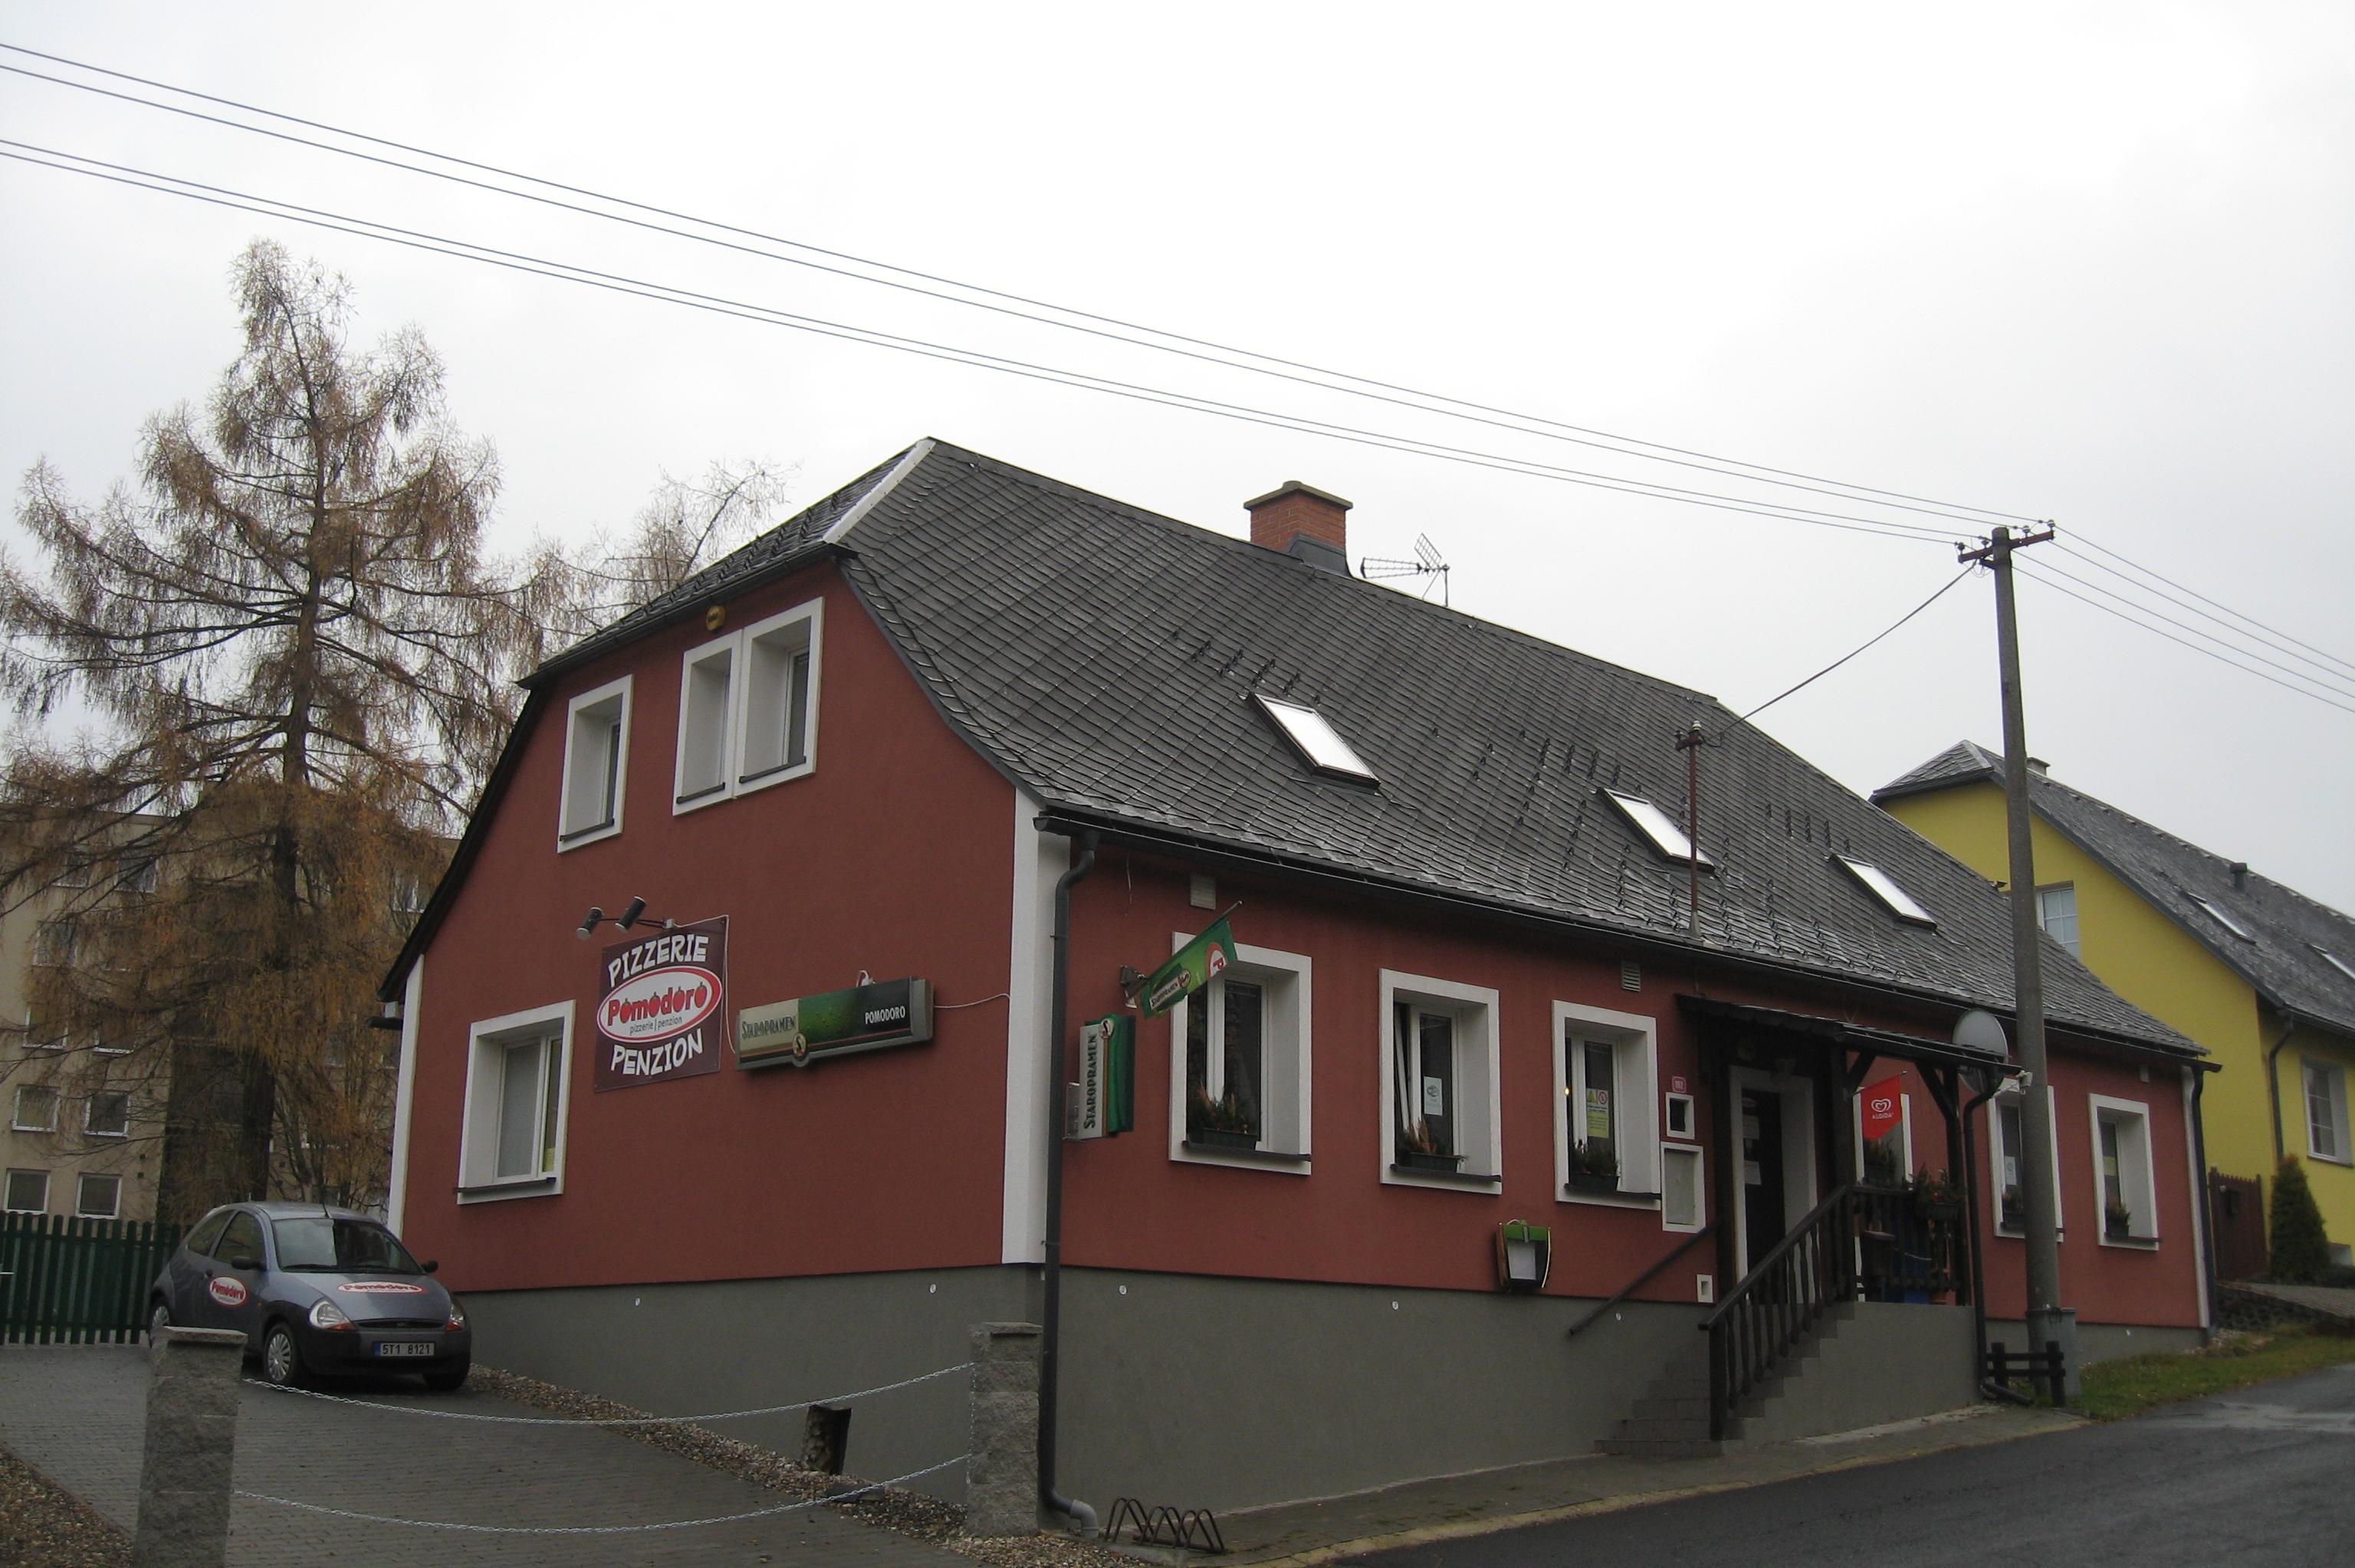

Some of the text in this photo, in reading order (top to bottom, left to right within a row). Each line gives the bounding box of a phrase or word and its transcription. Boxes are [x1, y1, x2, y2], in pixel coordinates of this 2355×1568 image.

[608, 933, 709, 988] PIZZERIE
[607, 982, 708, 1026] Pomodoro
[865, 1005, 906, 1025] POMODORO
[610, 1028, 703, 1076] PENZION
[1083, 1035, 1098, 1130] STAROPRAMEN
[383, 1343, 400, 1355] 5T1
